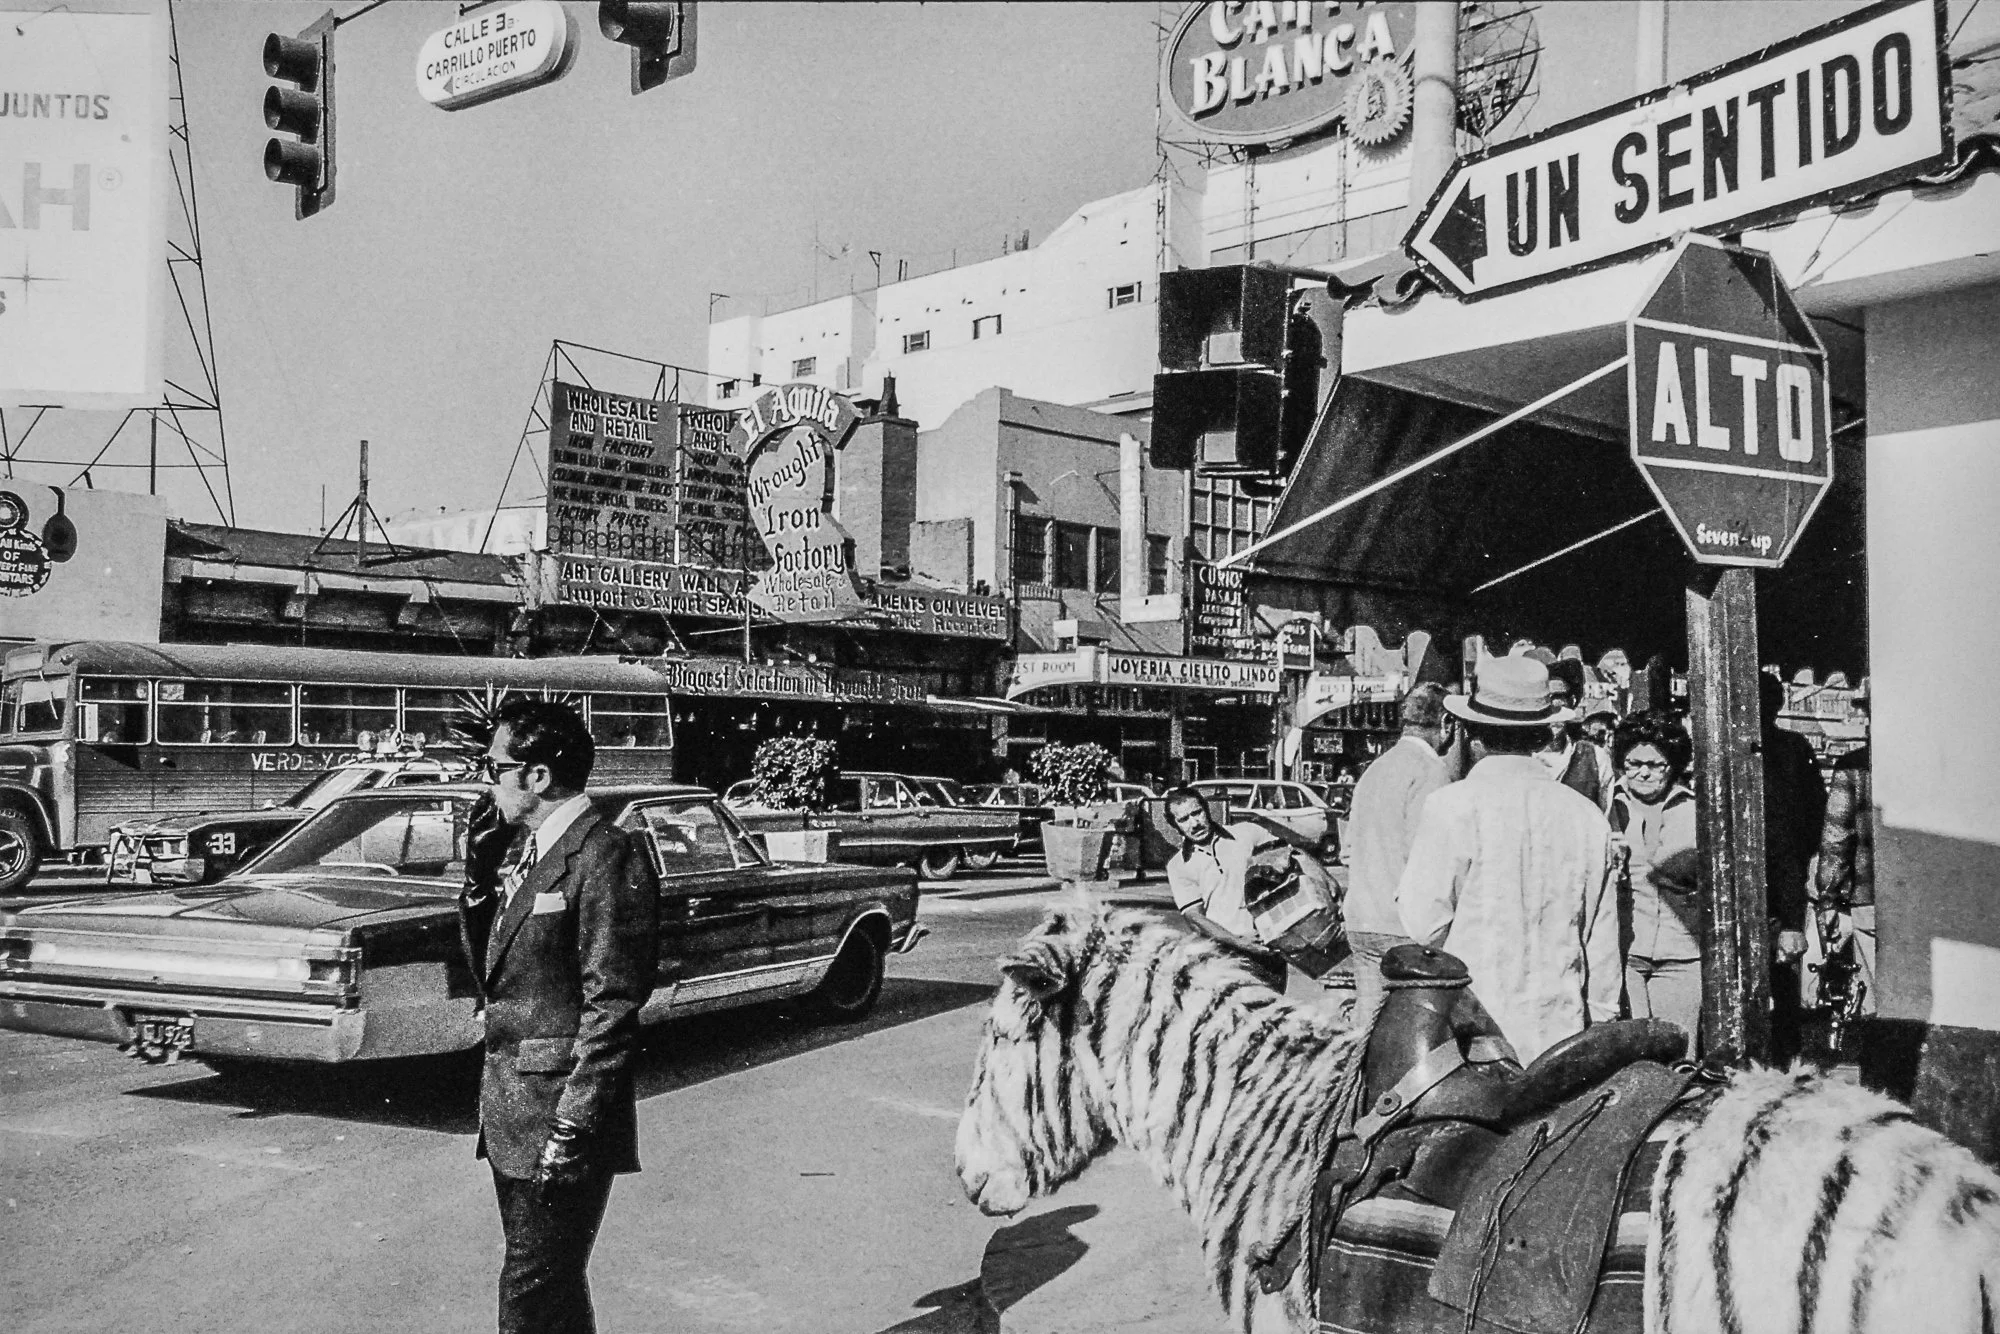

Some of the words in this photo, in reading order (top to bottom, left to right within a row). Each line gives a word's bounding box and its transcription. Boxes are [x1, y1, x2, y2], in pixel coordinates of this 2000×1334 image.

[444, 19, 490, 49] CALLE
[426, 47, 484, 80] CARRILLO
[488, 29, 536, 60] PUERTO
[1189, 11, 1396, 117] BLANCA
[1506, 152, 1580, 257] UN
[1612, 32, 1913, 225] SENTIDO
[567, 389, 659, 425] WHOLESALE
[1652, 341, 1813, 463] ALTO
[569, 412, 596, 435] AND
[603, 417, 653, 444] RETAIL
[602, 440, 655, 459] FACTORY
[749, 432, 823, 508] Wrought
[555, 504, 601, 522] FACTORY
[610, 510, 651, 529] PRICES
[764, 505, 820, 536] Iron
[3, 550, 21, 561] OF
[561, 561, 596, 583] ART
[599, 565, 672, 590] GALLERY
[680, 573, 723, 596] WALL
[773, 589, 837, 613] Retail
[931, 599, 953, 617] ON
[955, 601, 1006, 621] VELVET
[736, 665, 800, 695] Selection
[1042, 661, 1076, 673] ROOM
[1111, 658, 1172, 677] JOYERIA
[1180, 663, 1231, 680] CIELITO
[1239, 666, 1277, 683] LINDO
[251, 752, 314, 771] VERDE
[211, 832, 236, 855] 33
